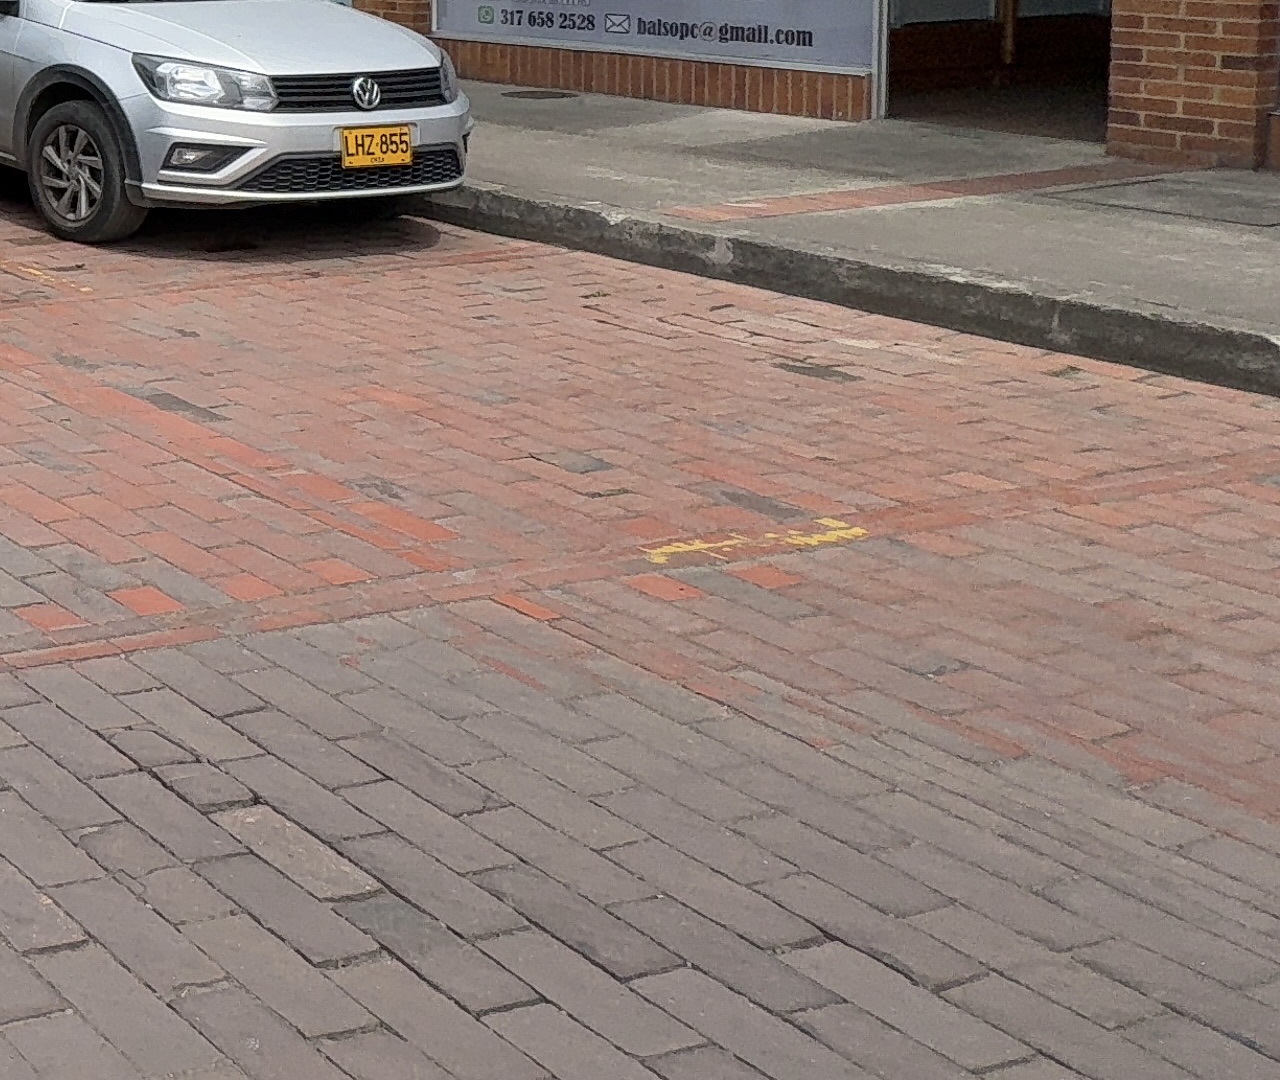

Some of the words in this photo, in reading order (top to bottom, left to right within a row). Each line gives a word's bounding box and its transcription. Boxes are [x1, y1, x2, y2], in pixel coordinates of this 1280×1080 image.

[500, 9, 524, 25] 317
[527, 11, 554, 28] 658
[558, 13, 596, 31] 2528
[637, 17, 813, 48] balsopc@gmail.com
